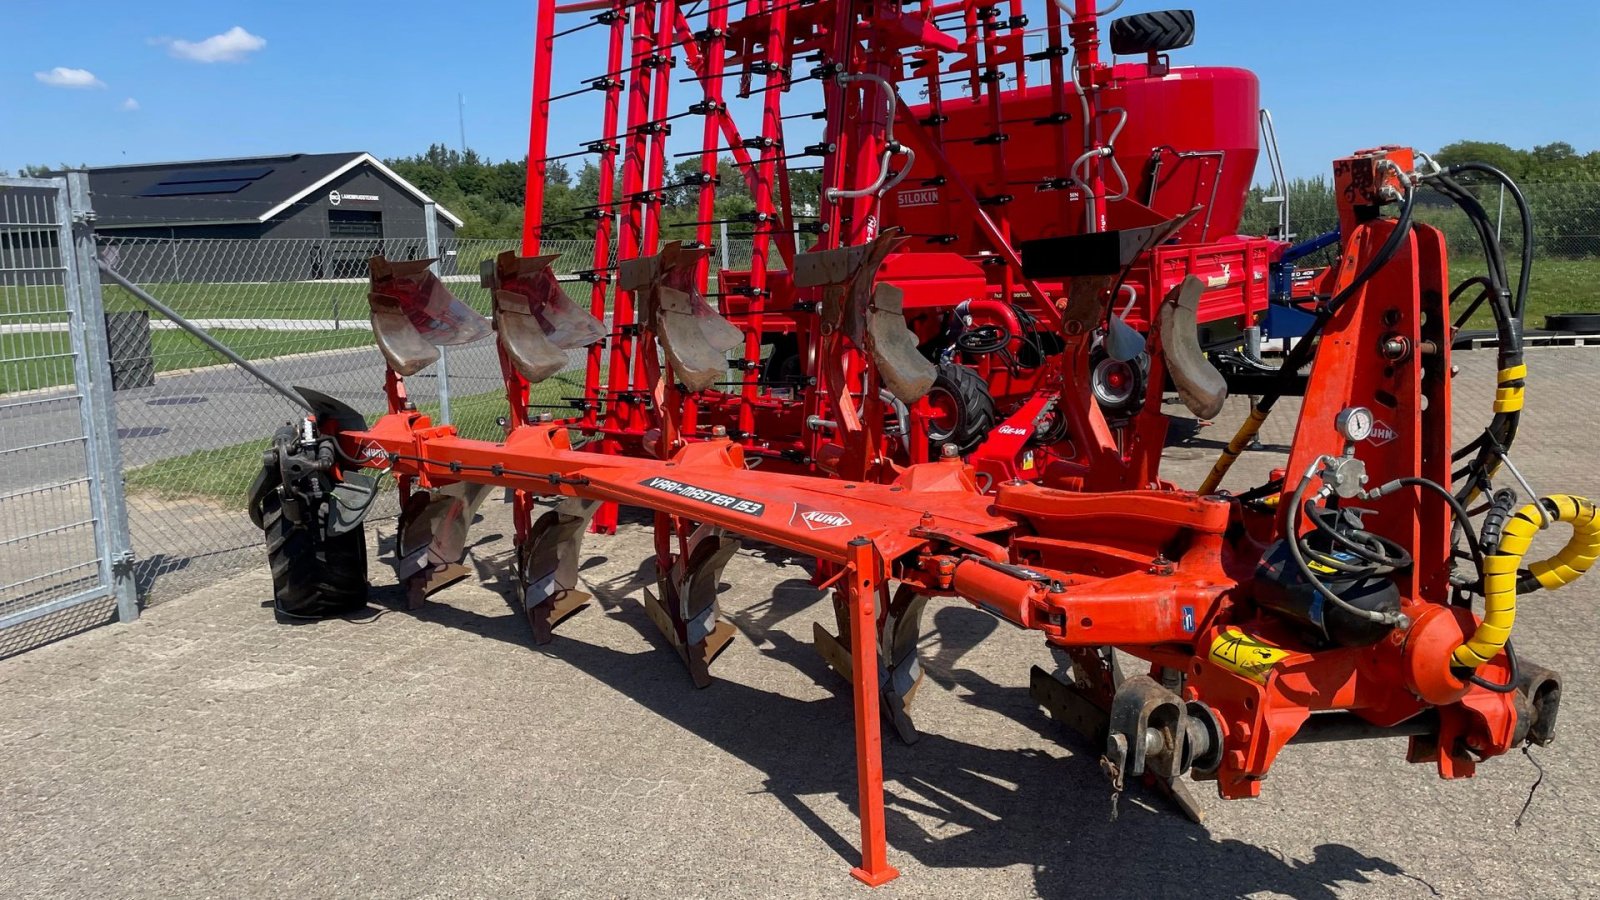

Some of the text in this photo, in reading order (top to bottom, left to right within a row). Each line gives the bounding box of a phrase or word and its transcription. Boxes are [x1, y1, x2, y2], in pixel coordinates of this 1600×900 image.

[898, 192, 938, 204] SILOKIN
[866, 215, 877, 244] HE-V
[999, 425, 1026, 435] HE-VA
[1370, 428, 1392, 439] UHN
[649, 477, 762, 513] VARI-MASTER 153
[807, 511, 845, 526] KUHN
